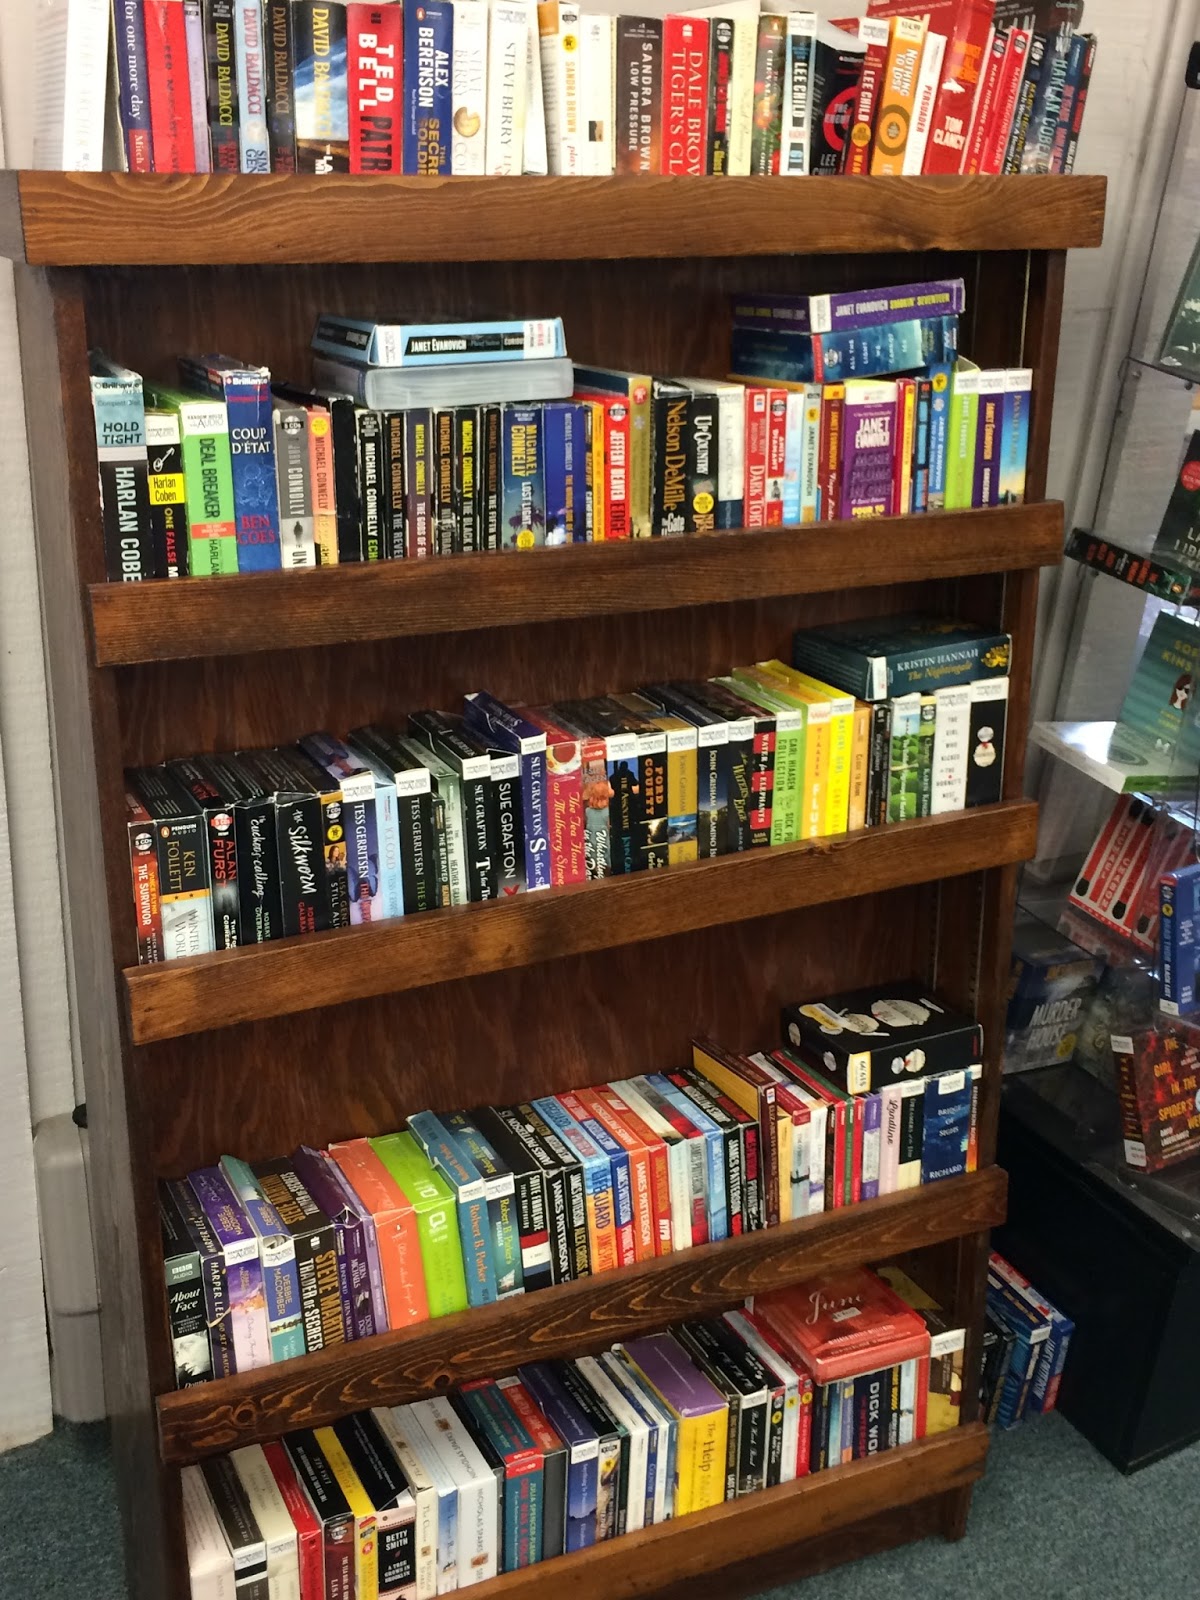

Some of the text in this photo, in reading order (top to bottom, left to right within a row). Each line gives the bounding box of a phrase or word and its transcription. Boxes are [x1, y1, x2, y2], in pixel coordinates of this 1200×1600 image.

[312, 7, 330, 57] DAVID
[125, 1, 144, 120] for one more day
[215, 22, 232, 126] DAVID BALDACCI
[244, 8, 261, 115] DAVID BALDACCI
[273, 7, 290, 113] DAVID BALDACCI
[358, 33, 378, 111] BELL
[375, 44, 394, 102] TED
[418, 27, 434, 108] BERENSON
[435, 50, 449, 87] ALEX
[687, 51, 704, 109] DALE
[900, 48, 917, 97] NOTHING
[628, 62, 640, 151] LOW PRESSURE
[640, 42, 654, 170] SANDRA BROWN
[669, 48, 687, 135] TIGER'S
[791, 62, 808, 118] LEE CHILD
[858, 71, 876, 122] LEE CHILD
[916, 85, 933, 134] PERSUADER
[1045, 59, 1068, 114] HARLAN
[134, 134, 143, 164] Mitch
[410, 338, 468, 352] JANET EVANOVICH
[102, 421, 140, 433] HOLD
[102, 434, 143, 444] TIGHT
[231, 428, 267, 440] COUP
[415, 424, 425, 458] MICHAEL
[694, 415, 713, 432] UP
[858, 417, 890, 434] JANET
[314, 437, 329, 510] MICHAEL CONNELLY
[390, 417, 403, 530] MICHAEL CONNELLY THE
[440, 416, 452, 503] MICHAEL CONNELLY
[510, 425, 526, 478] CONNELLY
[525, 425, 538, 477] MICHAEL
[662, 401, 688, 511] Nelson DeMille
[115, 466, 140, 532] HARLAN
[153, 477, 177, 489] Harlan
[154, 490, 178, 502] Coben
[199, 438, 221, 518] DEAL BREAKER
[287, 467, 305, 516] CONNOLLY
[365, 443, 380, 537] MICHAEL CONNELLY
[462, 420, 473, 544] MICHAEL BLACK
[749, 465, 765, 496] DARK
[240, 515, 271, 529] BEN
[521, 482, 533, 525] LOST LIGHT
[164, 507, 177, 564] ONE FALSE
[209, 539, 222, 576] HARLAN
[237, 530, 275, 544] COES
[896, 648, 979, 672] KRISTIN HANNAH
[644, 757, 655, 816] COUNTY
[654, 766, 665, 806] FORD
[709, 750, 718, 807] JOHN GRISHAM
[758, 734, 769, 824] WATER ELEPHANTS
[787, 738, 798, 790] CARL HIAASEN
[530, 756, 547, 854] SUE GRAFTON S
[553, 783, 561, 795] on
[171, 823, 197, 832] PENGUIN
[353, 803, 370, 878] TESS GERRITSEN
[411, 797, 426, 899] TESS GERRITSEN THE
[474, 785, 491, 870] SUE GRAFTON T
[499, 783, 517, 879] SUE GRAFTON
[568, 792, 583, 877] The House
[773, 819, 784, 842] LUCKY
[167, 840, 182, 891] FOLLETT
[183, 850, 197, 878] KEN
[212, 839, 227, 888] FURST
[224, 841, 237, 880] ALAN
[438, 845, 448, 883] BETRAYED
[138, 863, 153, 926] THE SURVIVOR
[330, 882, 339, 908] STILL
[187, 908, 200, 953] WINTER
[727, 1139, 741, 1166] JAMES
[929, 1164, 963, 1179] RICHARD
[470, 1204, 481, 1239] Robert
[500, 1198, 510, 1224] Robert
[592, 1168, 611, 1230] LIFEGUARD
[635, 1162, 652, 1247] JAMES PATTERSON
[551, 1180, 570, 1273] JAMES PATTERSON
[170, 1288, 201, 1304] About
[172, 1270, 194, 1281] AUDIO
[210, 1261, 225, 1319] HARPER LEE
[273, 1268, 286, 1316] MACOMBER
[282, 1273, 293, 1305] DEBBIE
[315, 1250, 338, 1294] STEVE
[175, 1300, 199, 1313] Face
[299, 1258, 324, 1351] TRADER SECRETS
[868, 1381, 880, 1423] DICK
[698, 1439, 715, 1473] Help
[385, 1530, 409, 1545] BETTY
[385, 1538, 409, 1552] SMITH
[331, 1578, 339, 1598] LISA
